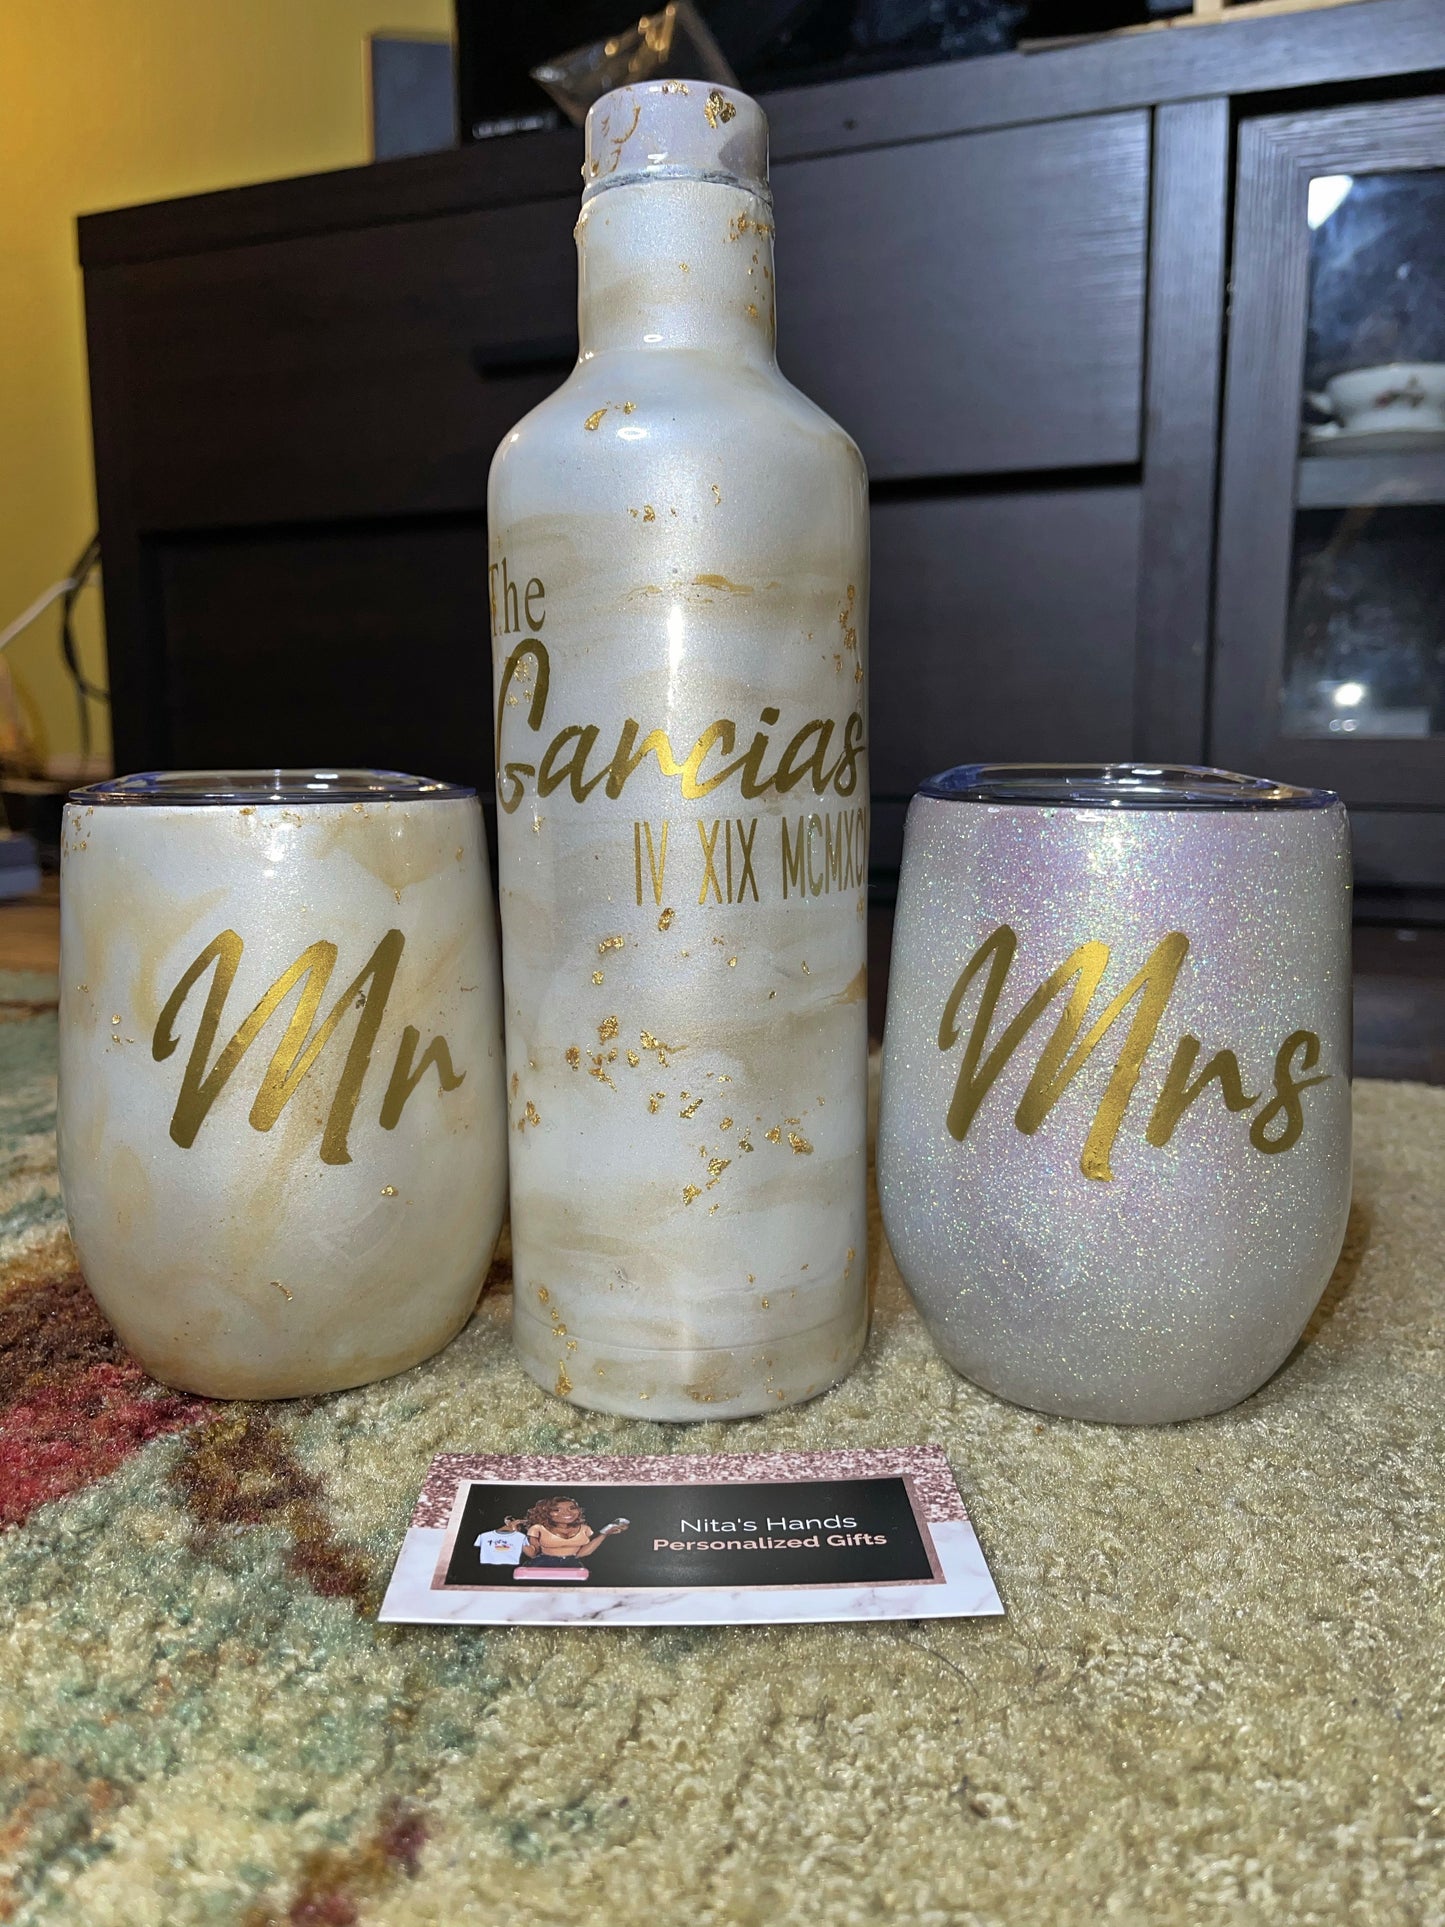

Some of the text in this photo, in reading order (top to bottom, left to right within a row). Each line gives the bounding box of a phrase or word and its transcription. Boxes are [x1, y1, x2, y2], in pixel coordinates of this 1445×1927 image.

[488, 556, 546, 637] The
[497, 638, 866, 815] Garcias
[633, 820, 668, 906] IV
[698, 817, 759, 905] XIX
[152, 928, 467, 1165] Mr
[938, 924, 1332, 1182] Mrs
[653, 1532, 888, 1551] Personalized Gifts
[680, 1514, 858, 1533] Nita's Hands
